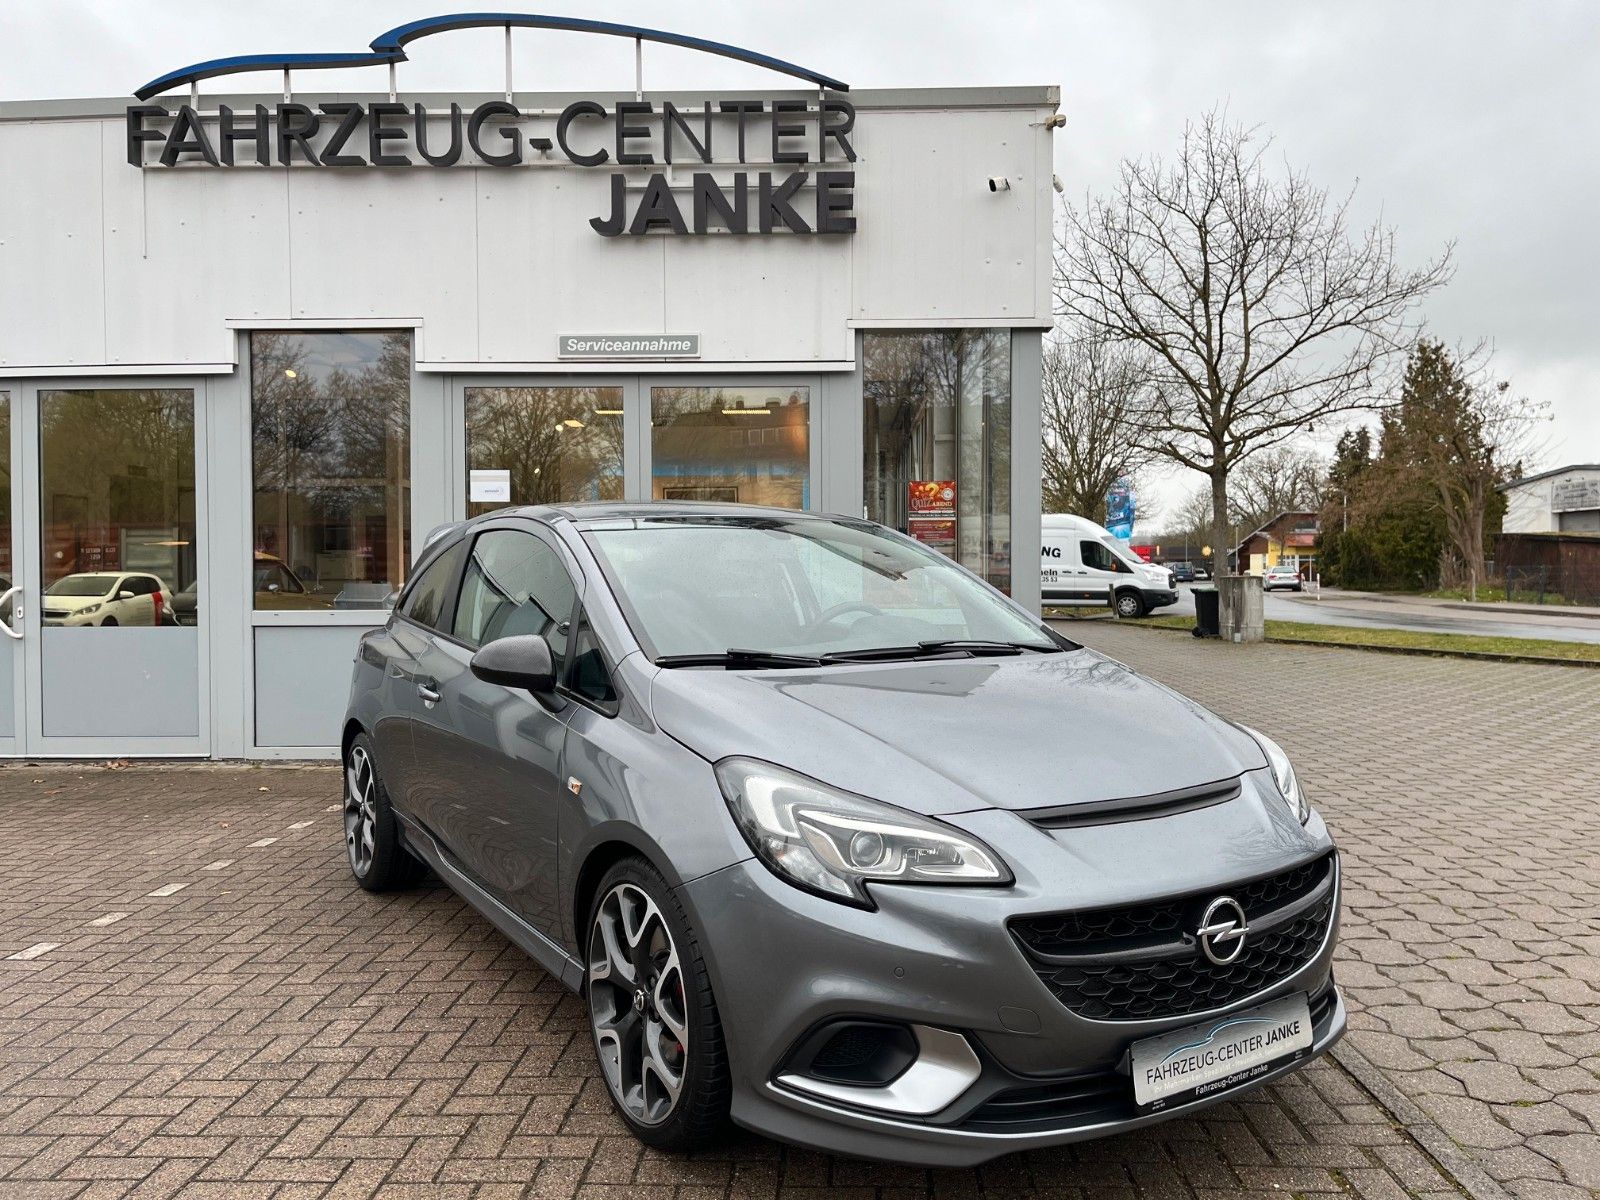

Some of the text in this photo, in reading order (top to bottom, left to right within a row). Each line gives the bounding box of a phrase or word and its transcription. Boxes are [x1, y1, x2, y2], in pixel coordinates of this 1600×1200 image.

[127, 99, 857, 168] FAHRZEUG-CENTER
[588, 170, 857, 237] JANKE
[567, 338, 692, 352] Serviceannahme
[1146, 1035, 1263, 1085] FAHRZEUG-CENTER
[1265, 1020, 1300, 1046] JANKE
[1195, 1064, 1269, 1096] Fahrzeug-Center Janke
